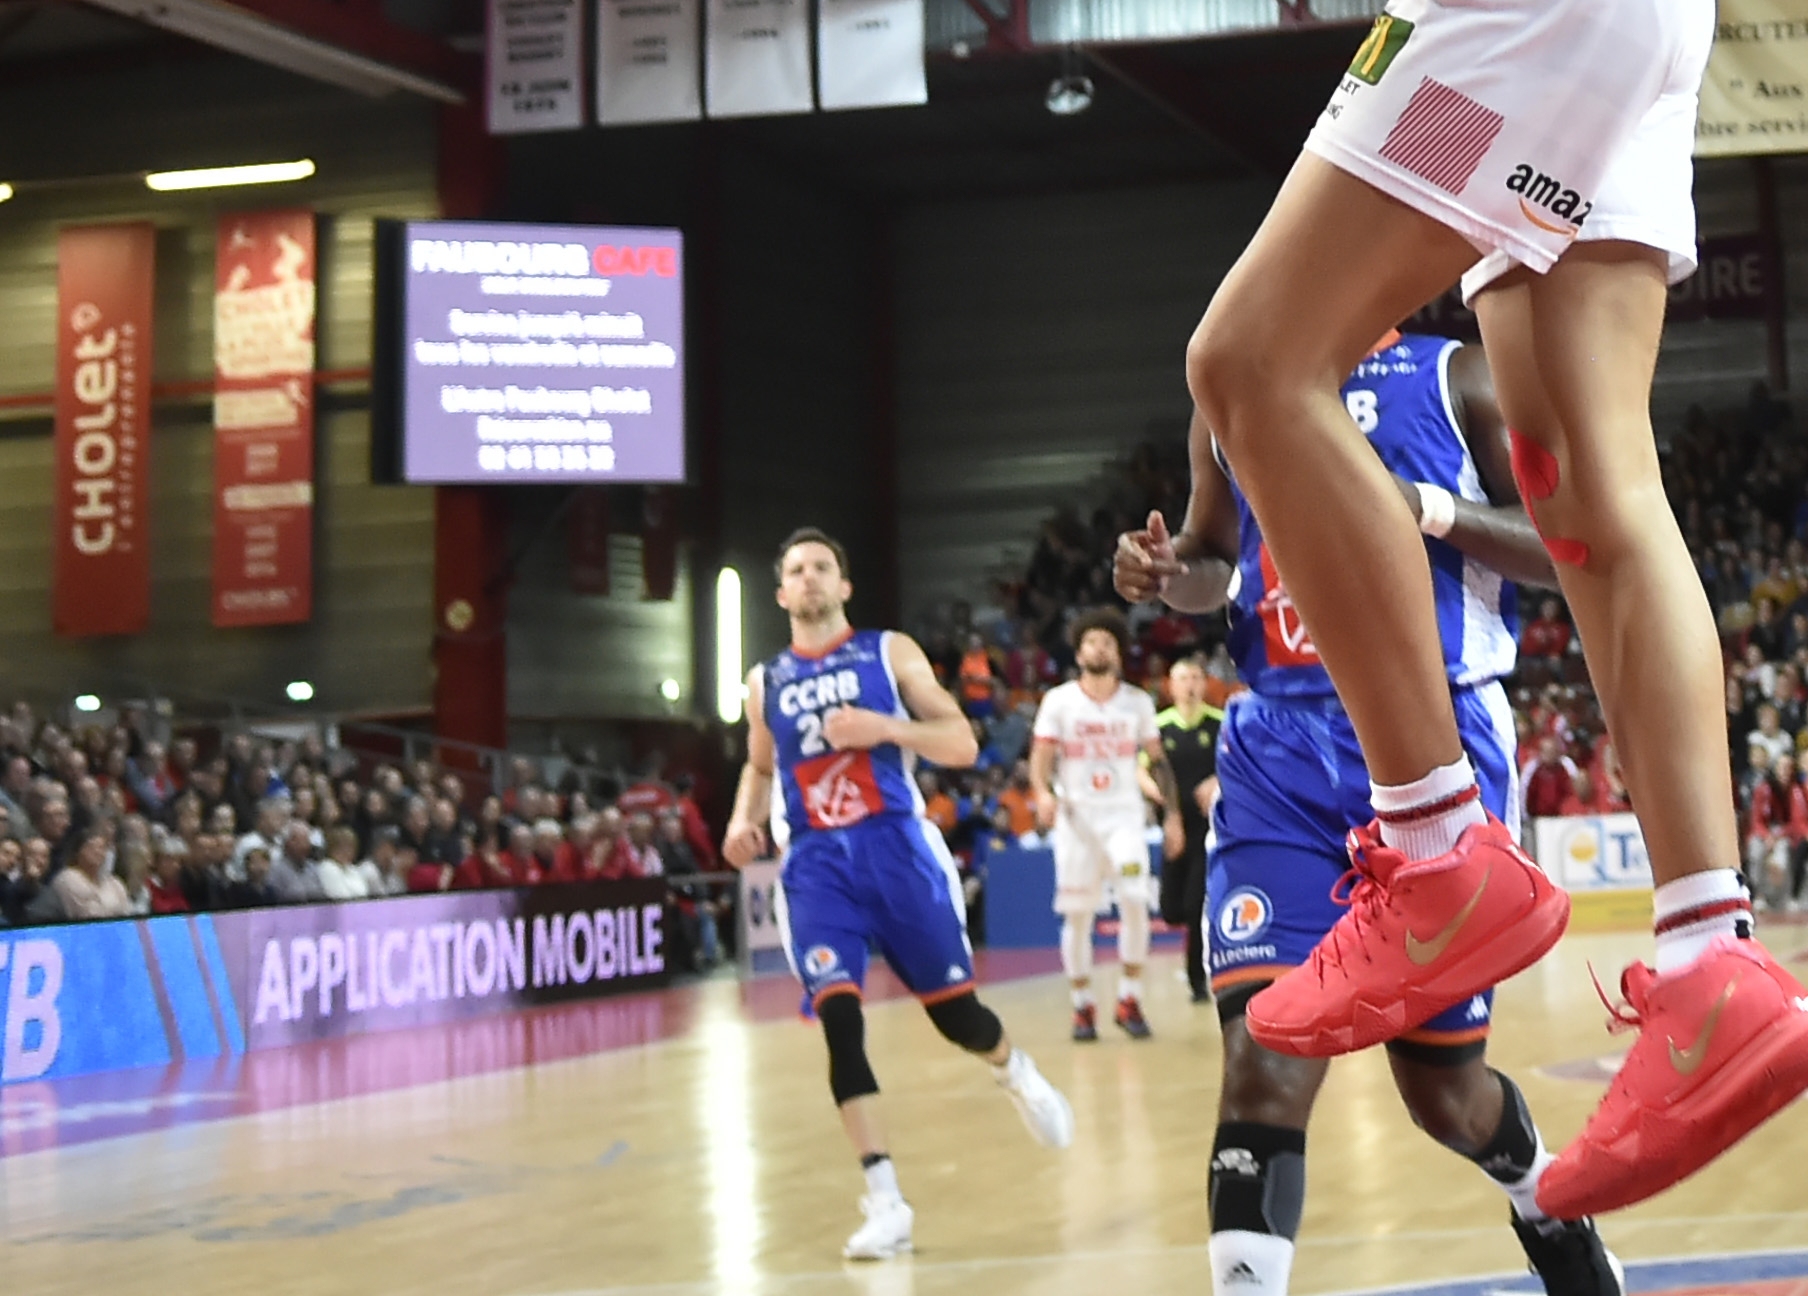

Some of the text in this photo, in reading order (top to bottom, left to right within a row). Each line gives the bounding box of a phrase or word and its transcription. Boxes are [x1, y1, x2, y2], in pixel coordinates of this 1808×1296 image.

[1752, 78, 1804, 100] Aux
[779, 669, 860, 718] CCRB
[796, 707, 847, 756] 2
[254, 903, 666, 1025] APPLICATION MOBILE
[0, 938, 65, 1082] B
